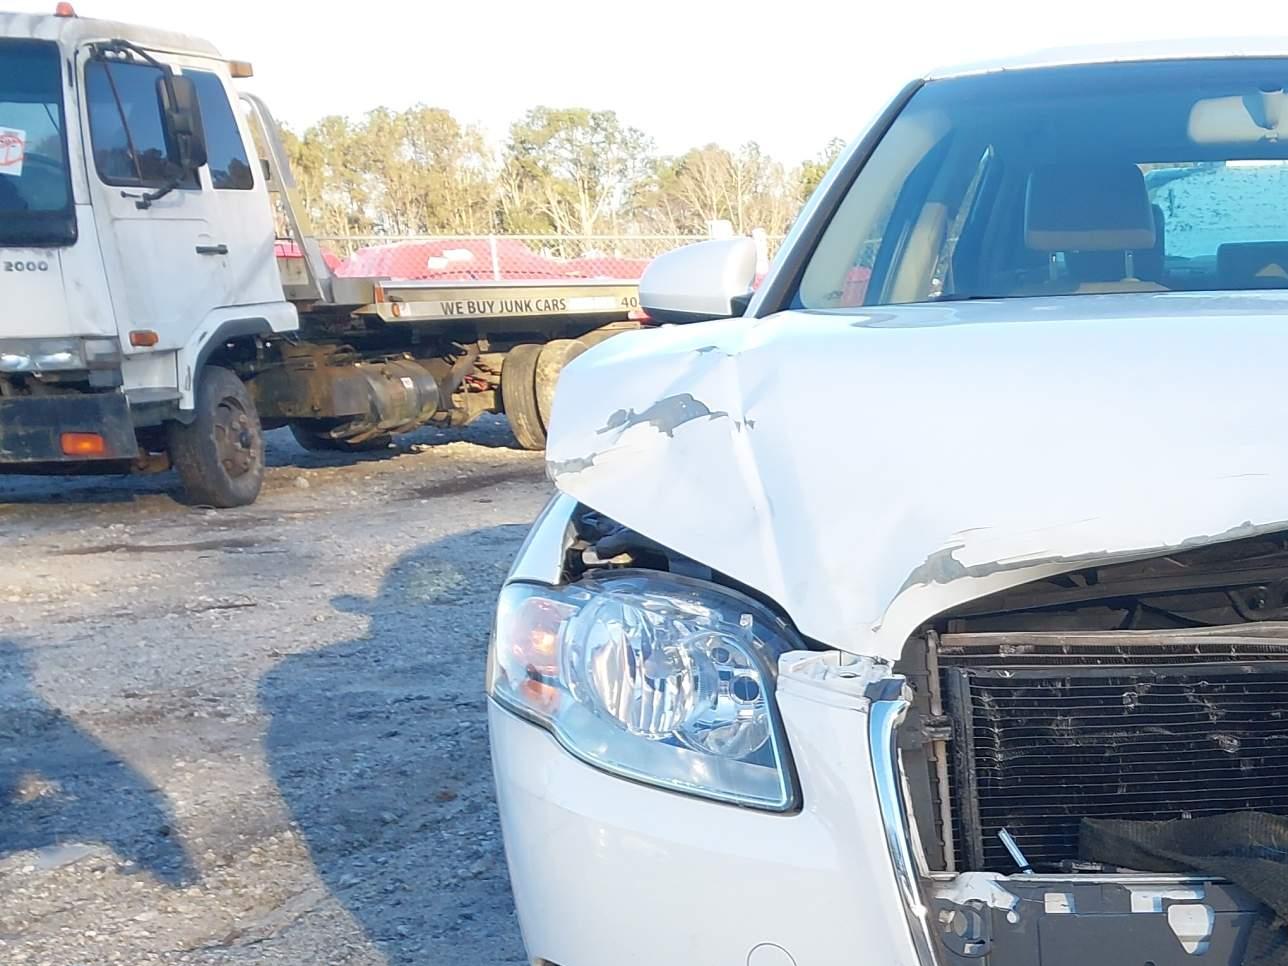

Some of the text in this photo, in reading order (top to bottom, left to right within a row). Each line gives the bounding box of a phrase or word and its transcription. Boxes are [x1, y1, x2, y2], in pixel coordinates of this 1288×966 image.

[3, 260, 49, 272] 2000
[440, 301, 464, 315] WE
[467, 300, 495, 314] BUY
[499, 299, 532, 313] JUNK
[535, 297, 567, 312] CARS
